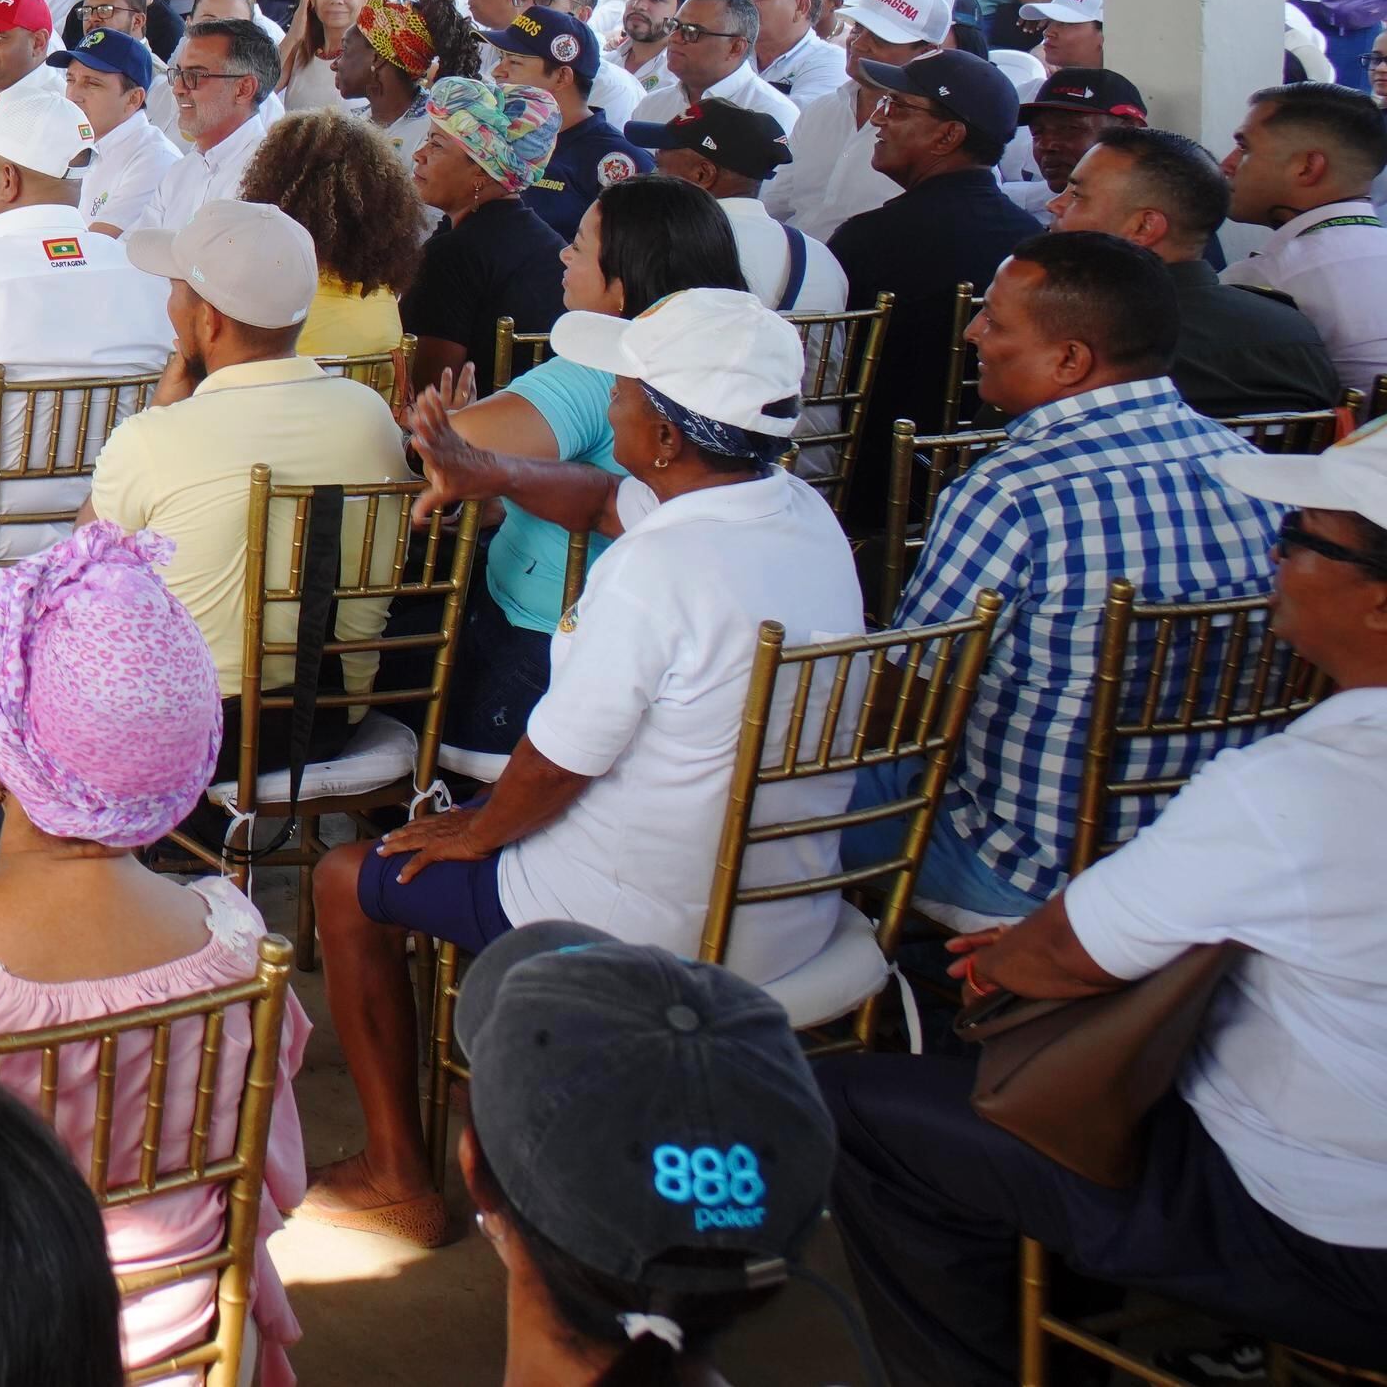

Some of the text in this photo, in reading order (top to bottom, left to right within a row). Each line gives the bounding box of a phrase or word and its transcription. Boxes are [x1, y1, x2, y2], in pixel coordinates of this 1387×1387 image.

[51, 260, 87, 268] CARTAGENA
[653, 1143, 765, 1205] 888
[694, 1205, 767, 1231] poker
